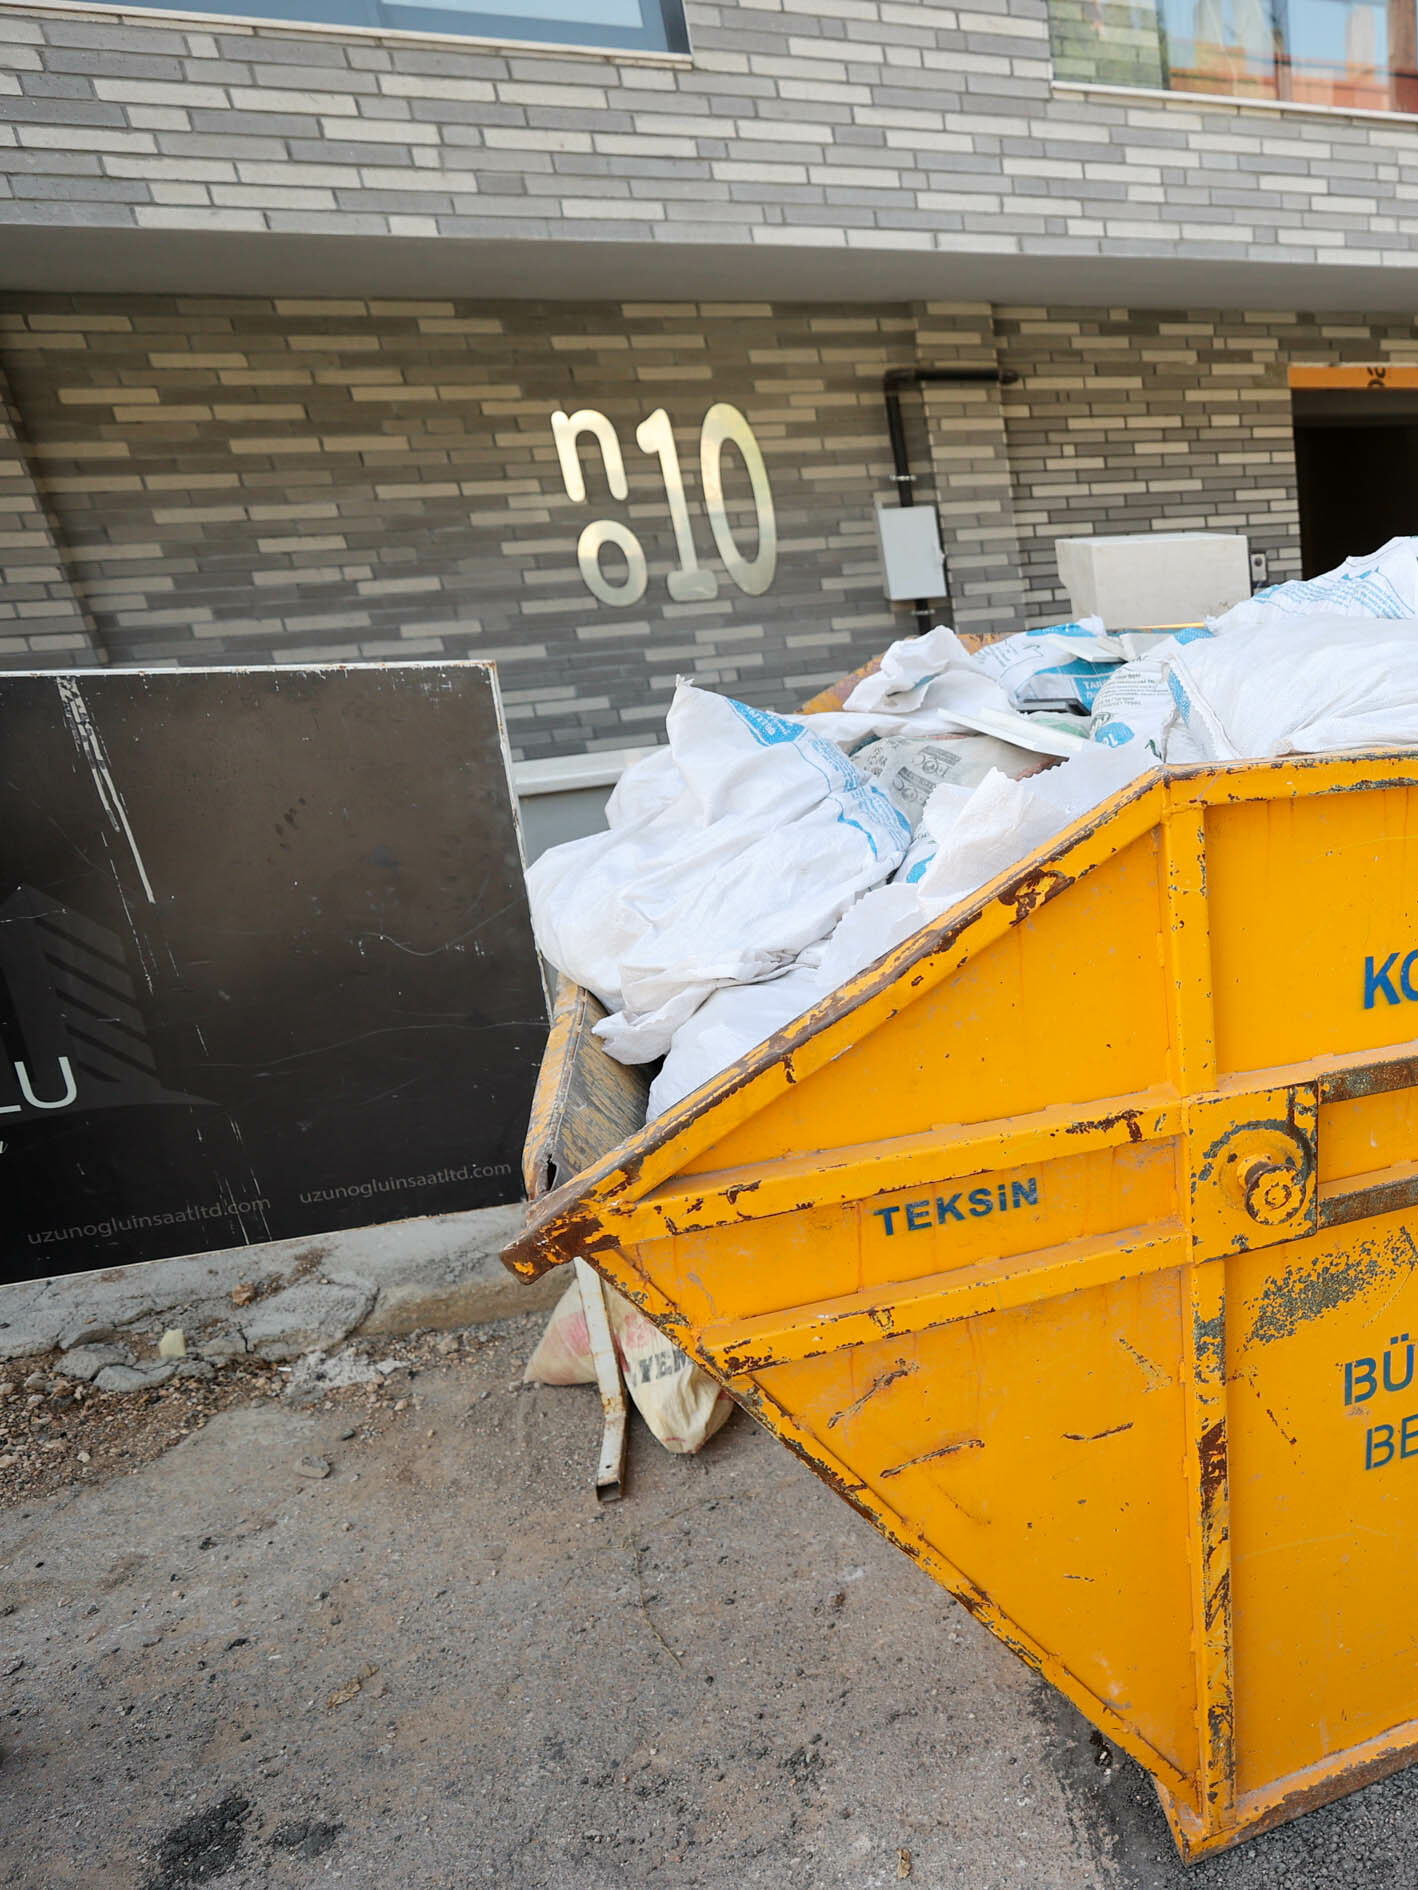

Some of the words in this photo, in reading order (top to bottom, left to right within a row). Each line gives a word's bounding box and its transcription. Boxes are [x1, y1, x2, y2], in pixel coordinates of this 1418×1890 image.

[636, 402, 777, 601] 10
[299, 1162, 512, 1205] uzunogluinsaatltd.com
[27, 1197, 271, 1246] uzunogluinsaatltd.com
